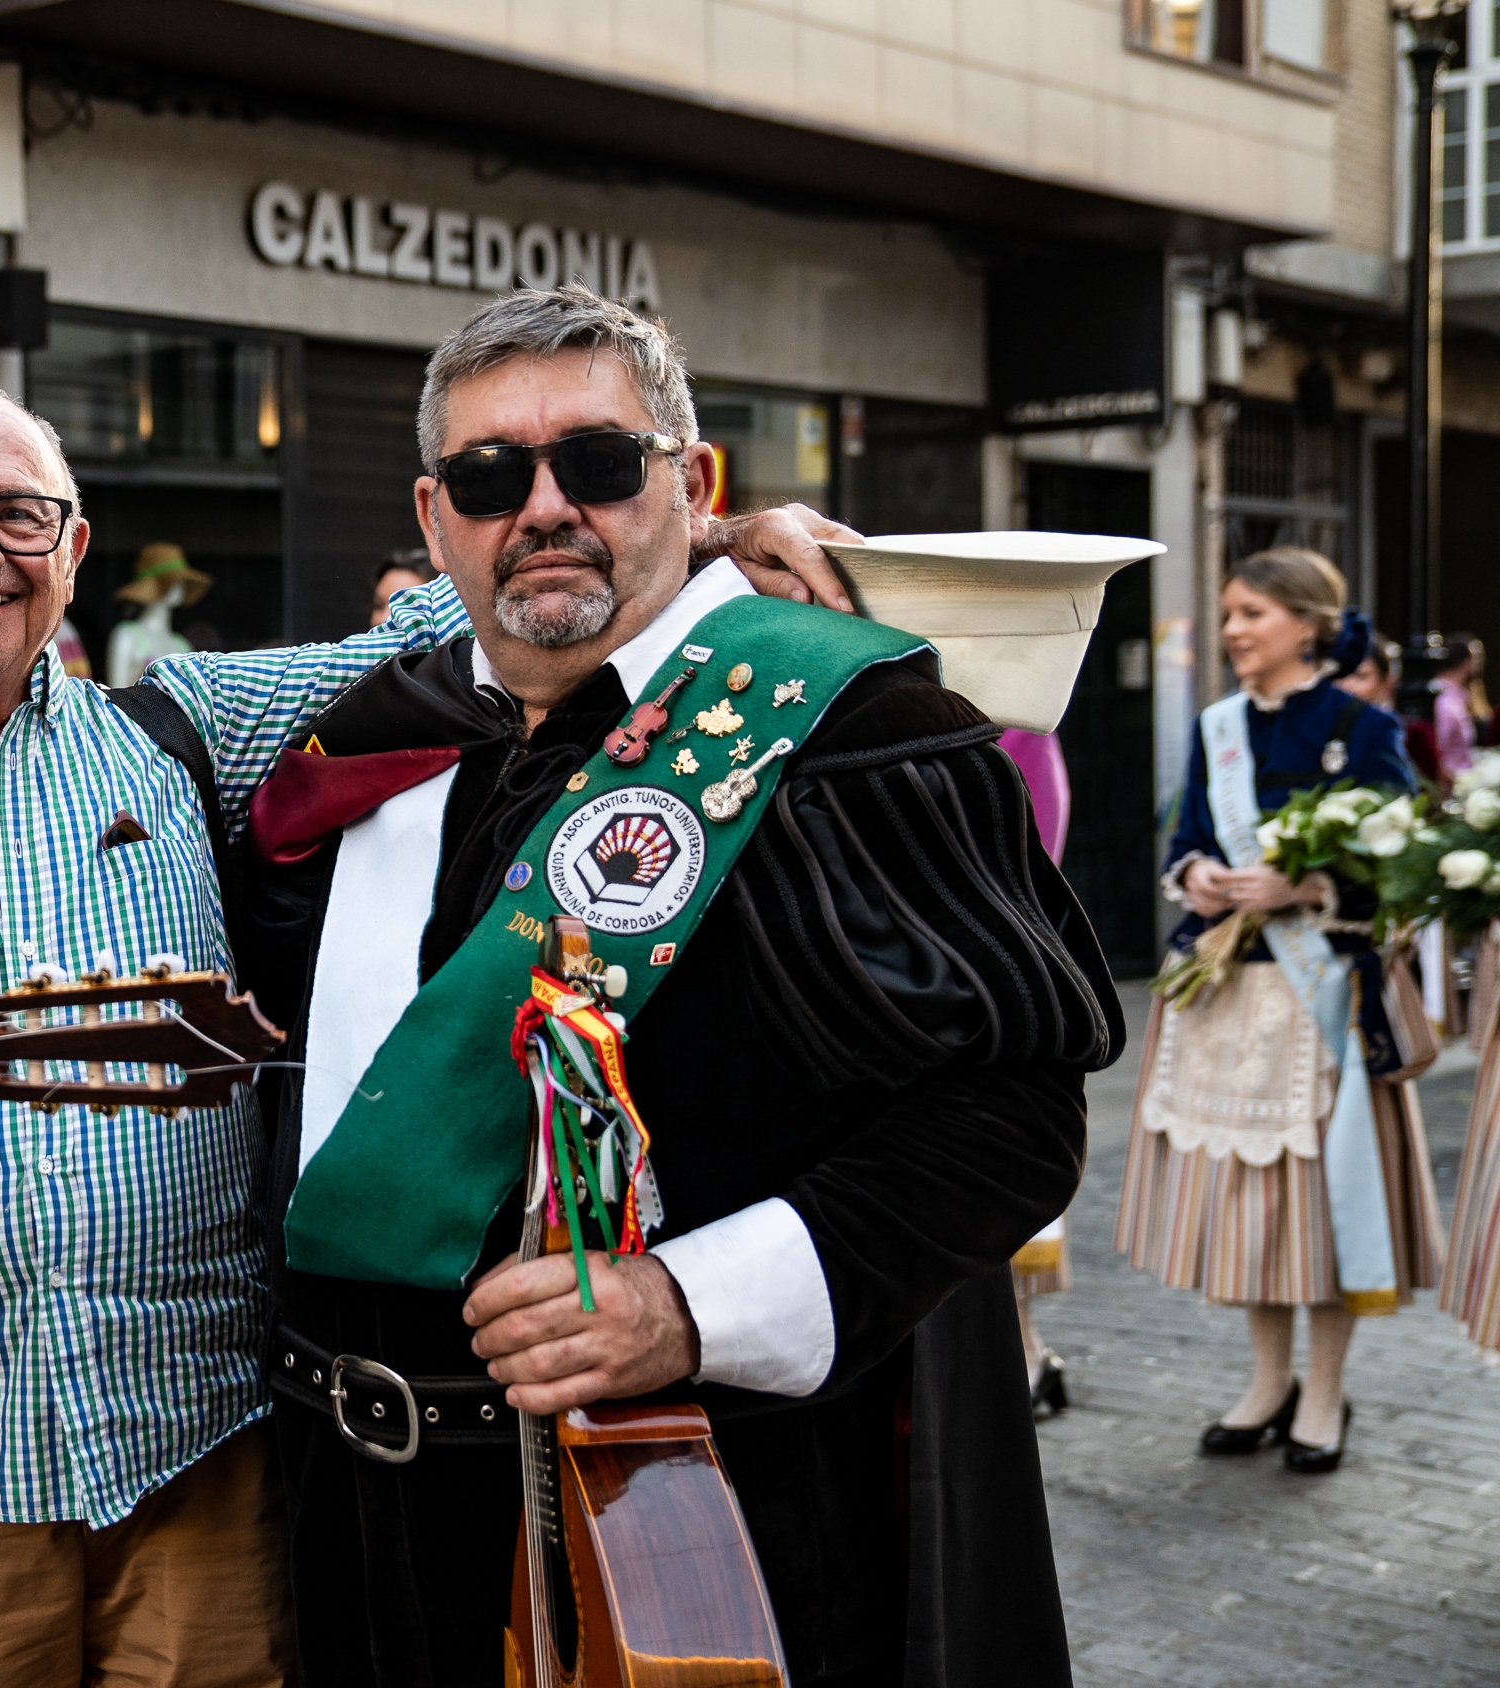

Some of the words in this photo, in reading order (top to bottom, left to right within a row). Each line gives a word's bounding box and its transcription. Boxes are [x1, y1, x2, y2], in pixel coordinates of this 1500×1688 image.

[251, 181, 660, 311] CALZEDONIA
[551, 851, 587, 916] CUARENTUNA
[588, 910, 603, 924] DE
[605, 912, 665, 930] CORDOBA
[593, 794, 633, 815] ANTIG.
[635, 791, 676, 813] TUNOS
[674, 808, 702, 903] UNIVERSITARIOS
